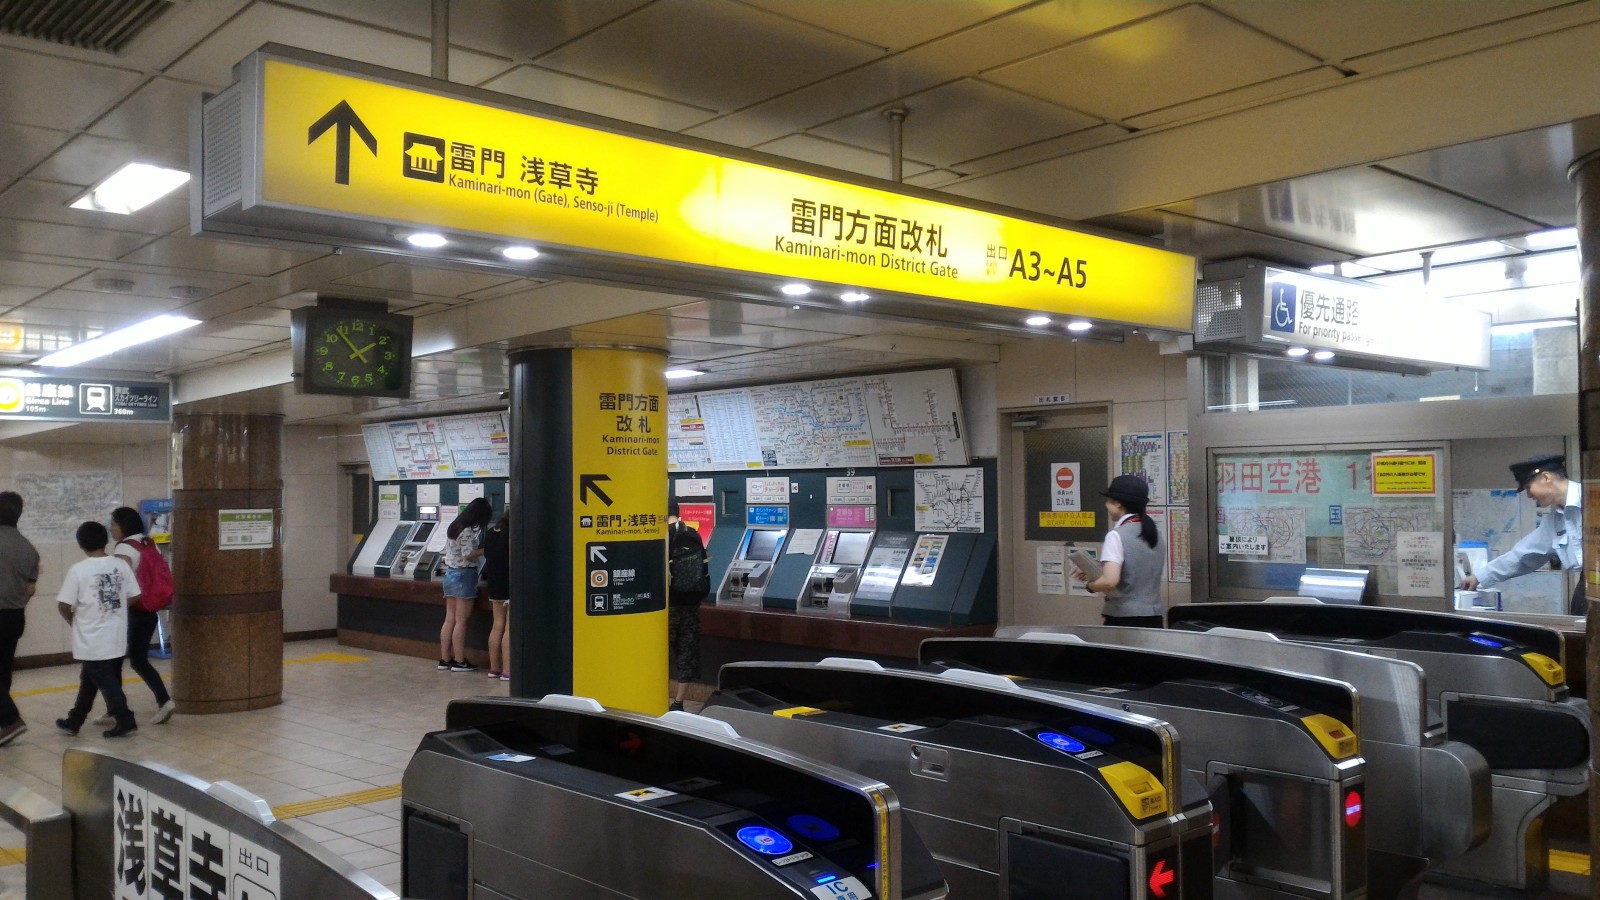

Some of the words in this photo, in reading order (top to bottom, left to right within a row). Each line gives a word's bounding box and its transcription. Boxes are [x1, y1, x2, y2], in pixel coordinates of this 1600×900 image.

[450, 141, 506, 179] 雷門
[520, 154, 599, 196] 浅草寺
[449, 174, 531, 200] Kaminari-mon
[533, 187, 571, 209] (Gate),
[573, 195, 614, 217] Senso-ji
[616, 202, 659, 224] (Temple)
[791, 197, 948, 258] 雷門方面改札
[986, 243, 1008, 260] 出口
[775, 235, 876, 266] Kaminari-mon
[881, 252, 926, 275] District
[930, 261, 958, 279] Gate
[1300, 289, 1358, 326] 優先通路
[352, 322, 364, 331] 12
[1298, 321, 1311, 335] For
[1312, 326, 1340, 343] priority
[326, 334, 338, 343] 10
[379, 336, 387, 345] 2
[320, 346, 328, 355] 9
[384, 351, 392, 360] 3
[325, 361, 333, 371] 8
[377, 365, 385, 374] 4
[338, 371, 346, 380] 7
[351, 375, 360, 385] 6
[365, 373, 373, 382] 5
[51, 398, 70, 406] Line
[599, 392, 659, 412] 雷門方面
[25, 405, 46, 413] 105m
[113, 407, 134, 415] 360m
[616, 415, 651, 433] 改札
[602, 434, 660, 444] Kaminari-mon
[607, 446, 640, 456] District
[642, 446, 658, 456] Gate
[1216, 457, 1322, 494] 羽田空港
[1056, 497, 1075, 506] 立入禁止
[596, 514, 656, 528] 雷門・浅草寺
[238, 847, 269, 876] 出口
[825, 881, 849, 895] IC
